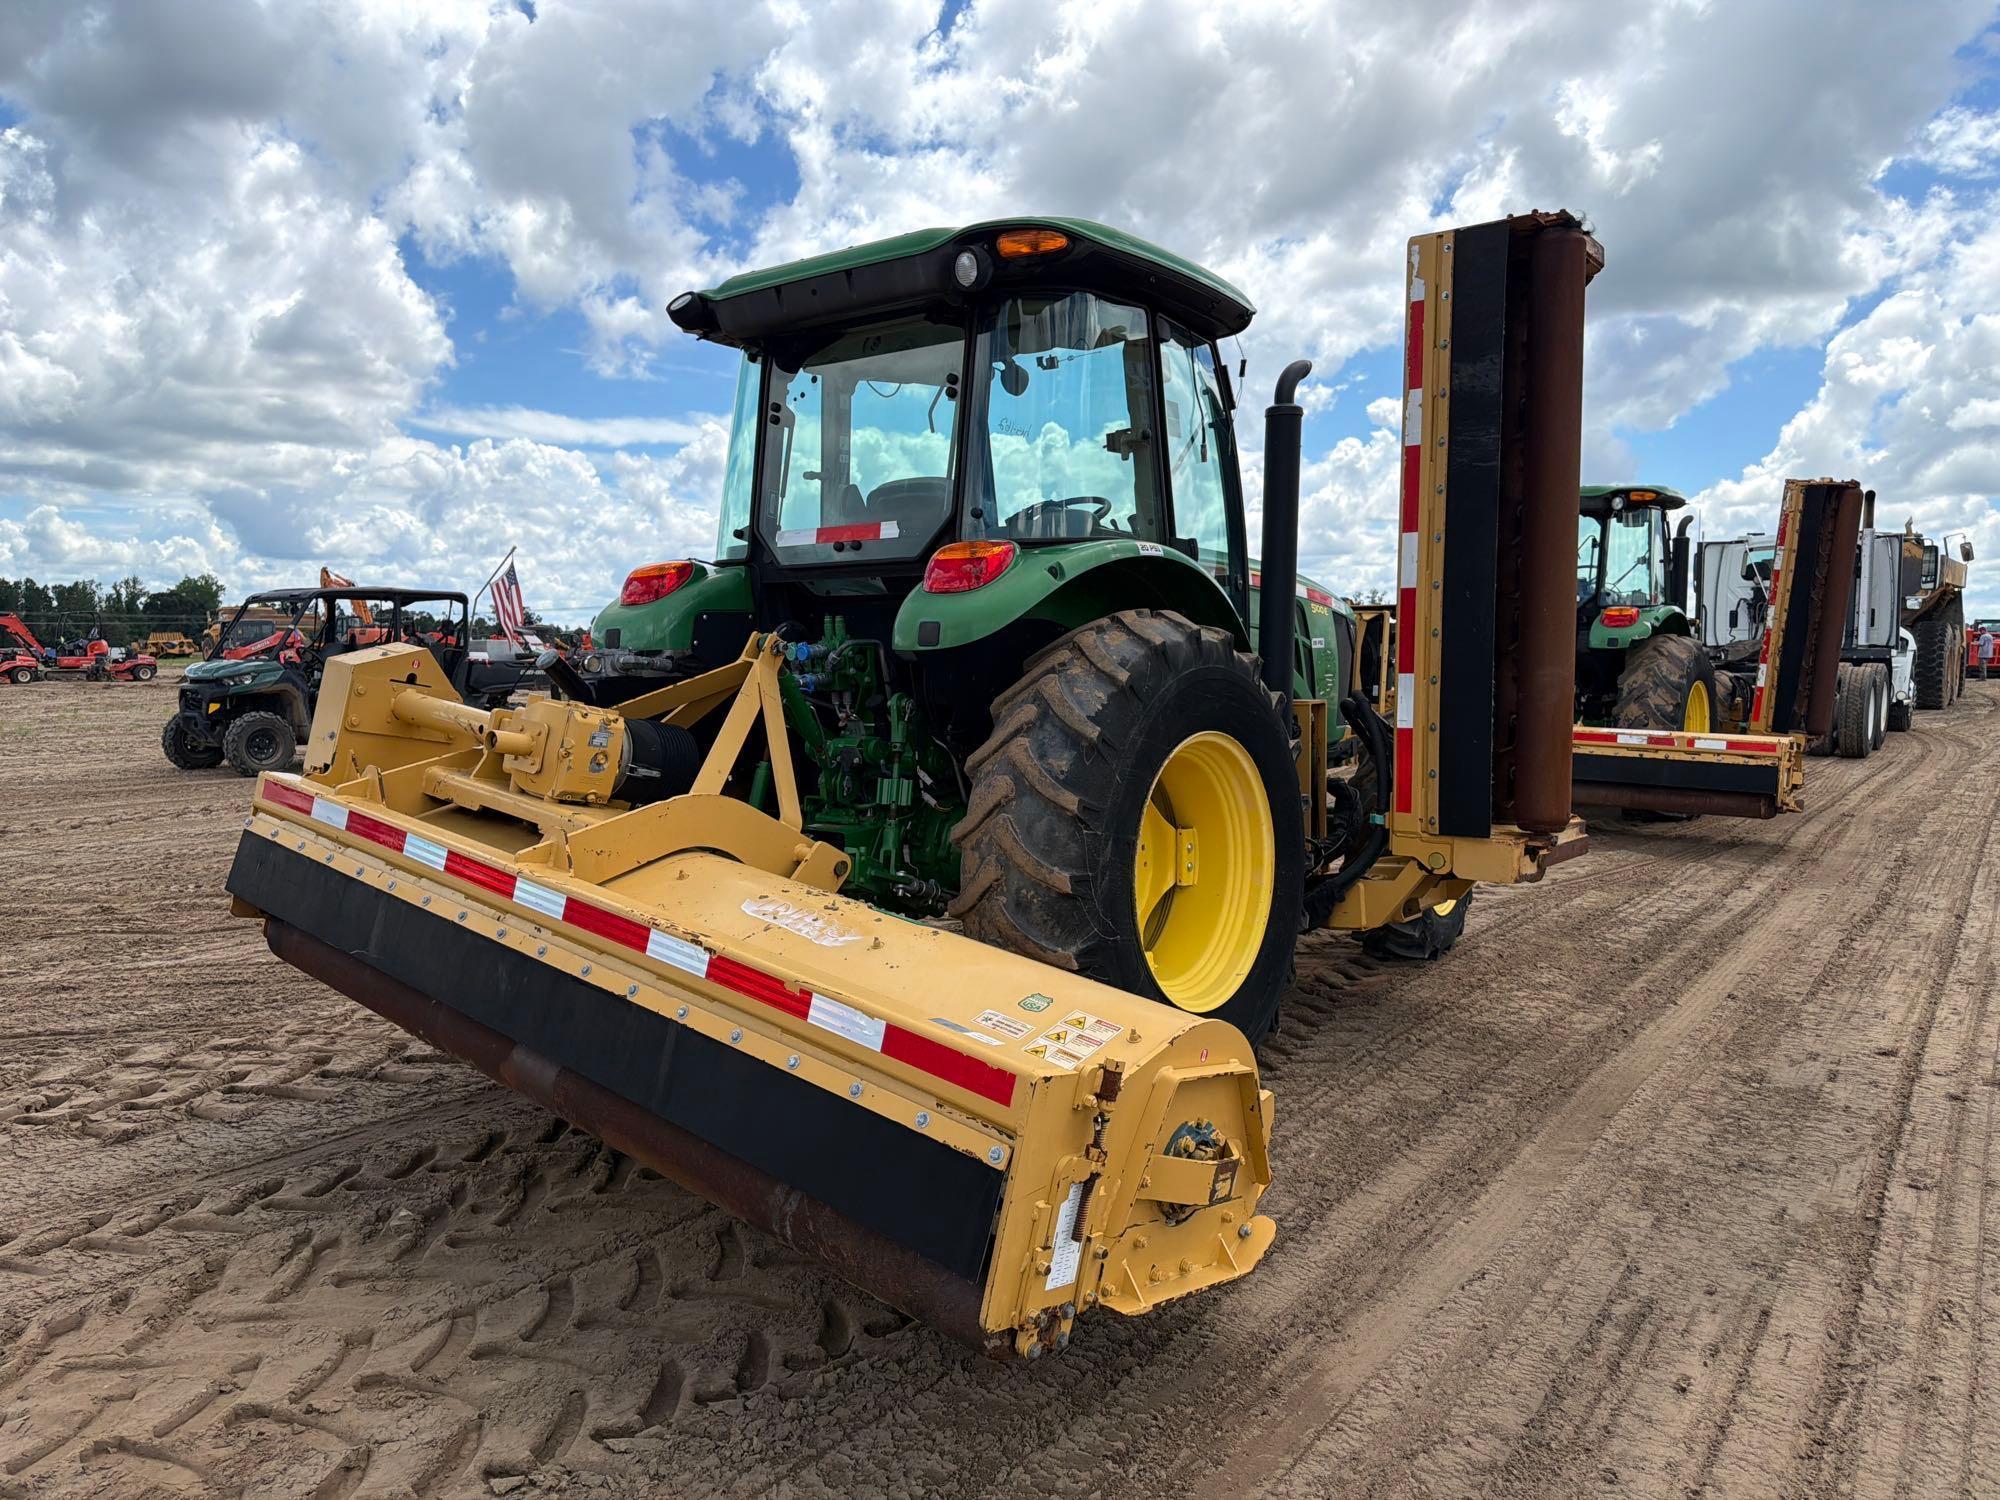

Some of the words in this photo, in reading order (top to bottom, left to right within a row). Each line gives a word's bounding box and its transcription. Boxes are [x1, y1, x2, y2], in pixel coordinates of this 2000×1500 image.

[1140, 544, 1149, 552] 20
[1150, 544, 1161, 553] PSI
[1023, 1000, 1041, 1011] USA
